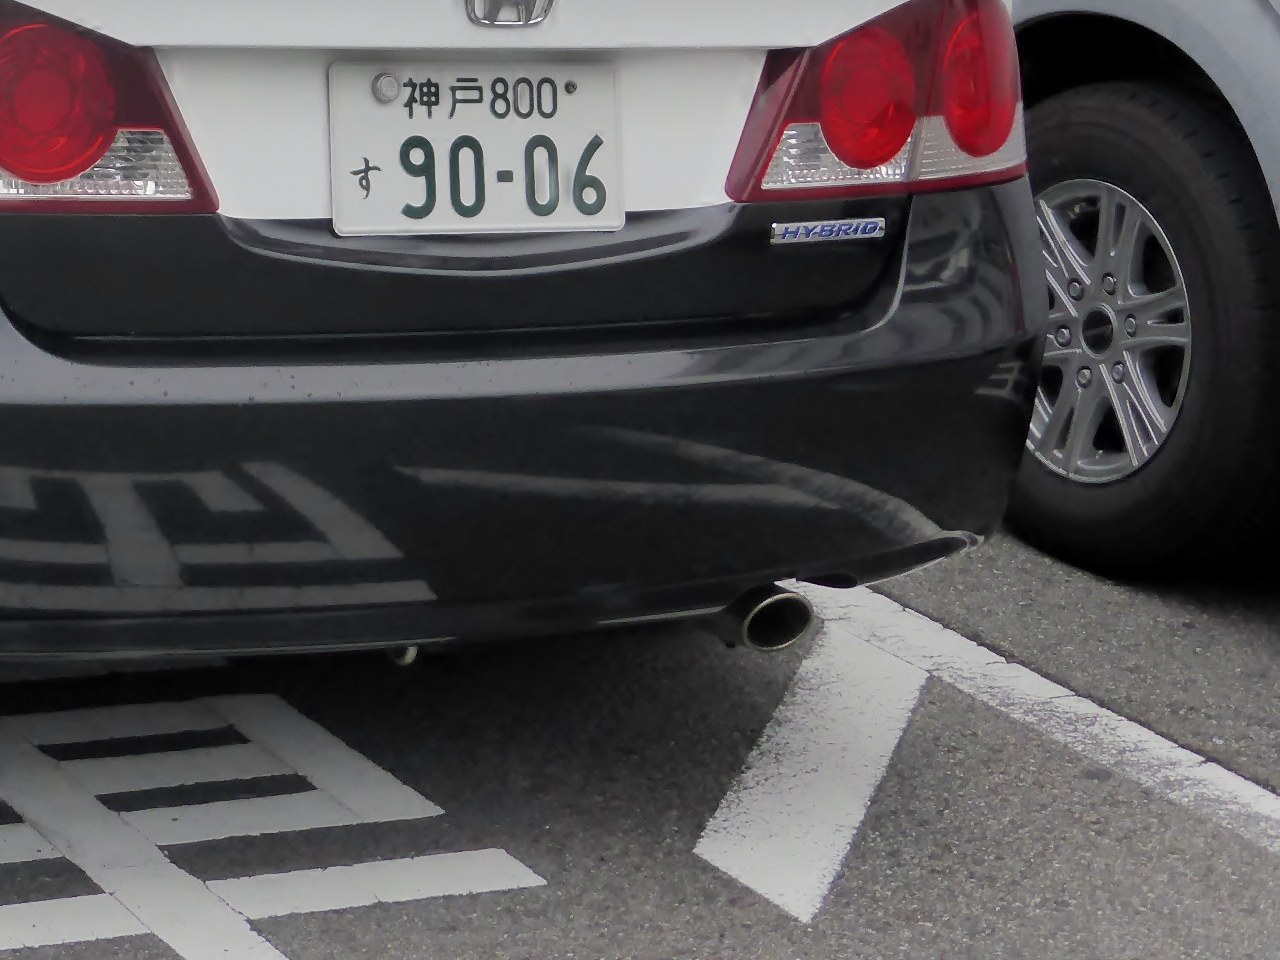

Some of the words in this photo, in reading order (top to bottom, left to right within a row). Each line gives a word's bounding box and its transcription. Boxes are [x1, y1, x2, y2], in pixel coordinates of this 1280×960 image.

[349, 156, 382, 200] す
[398, 133, 607, 220] 90-06
[781, 221, 880, 240] HYBRID
